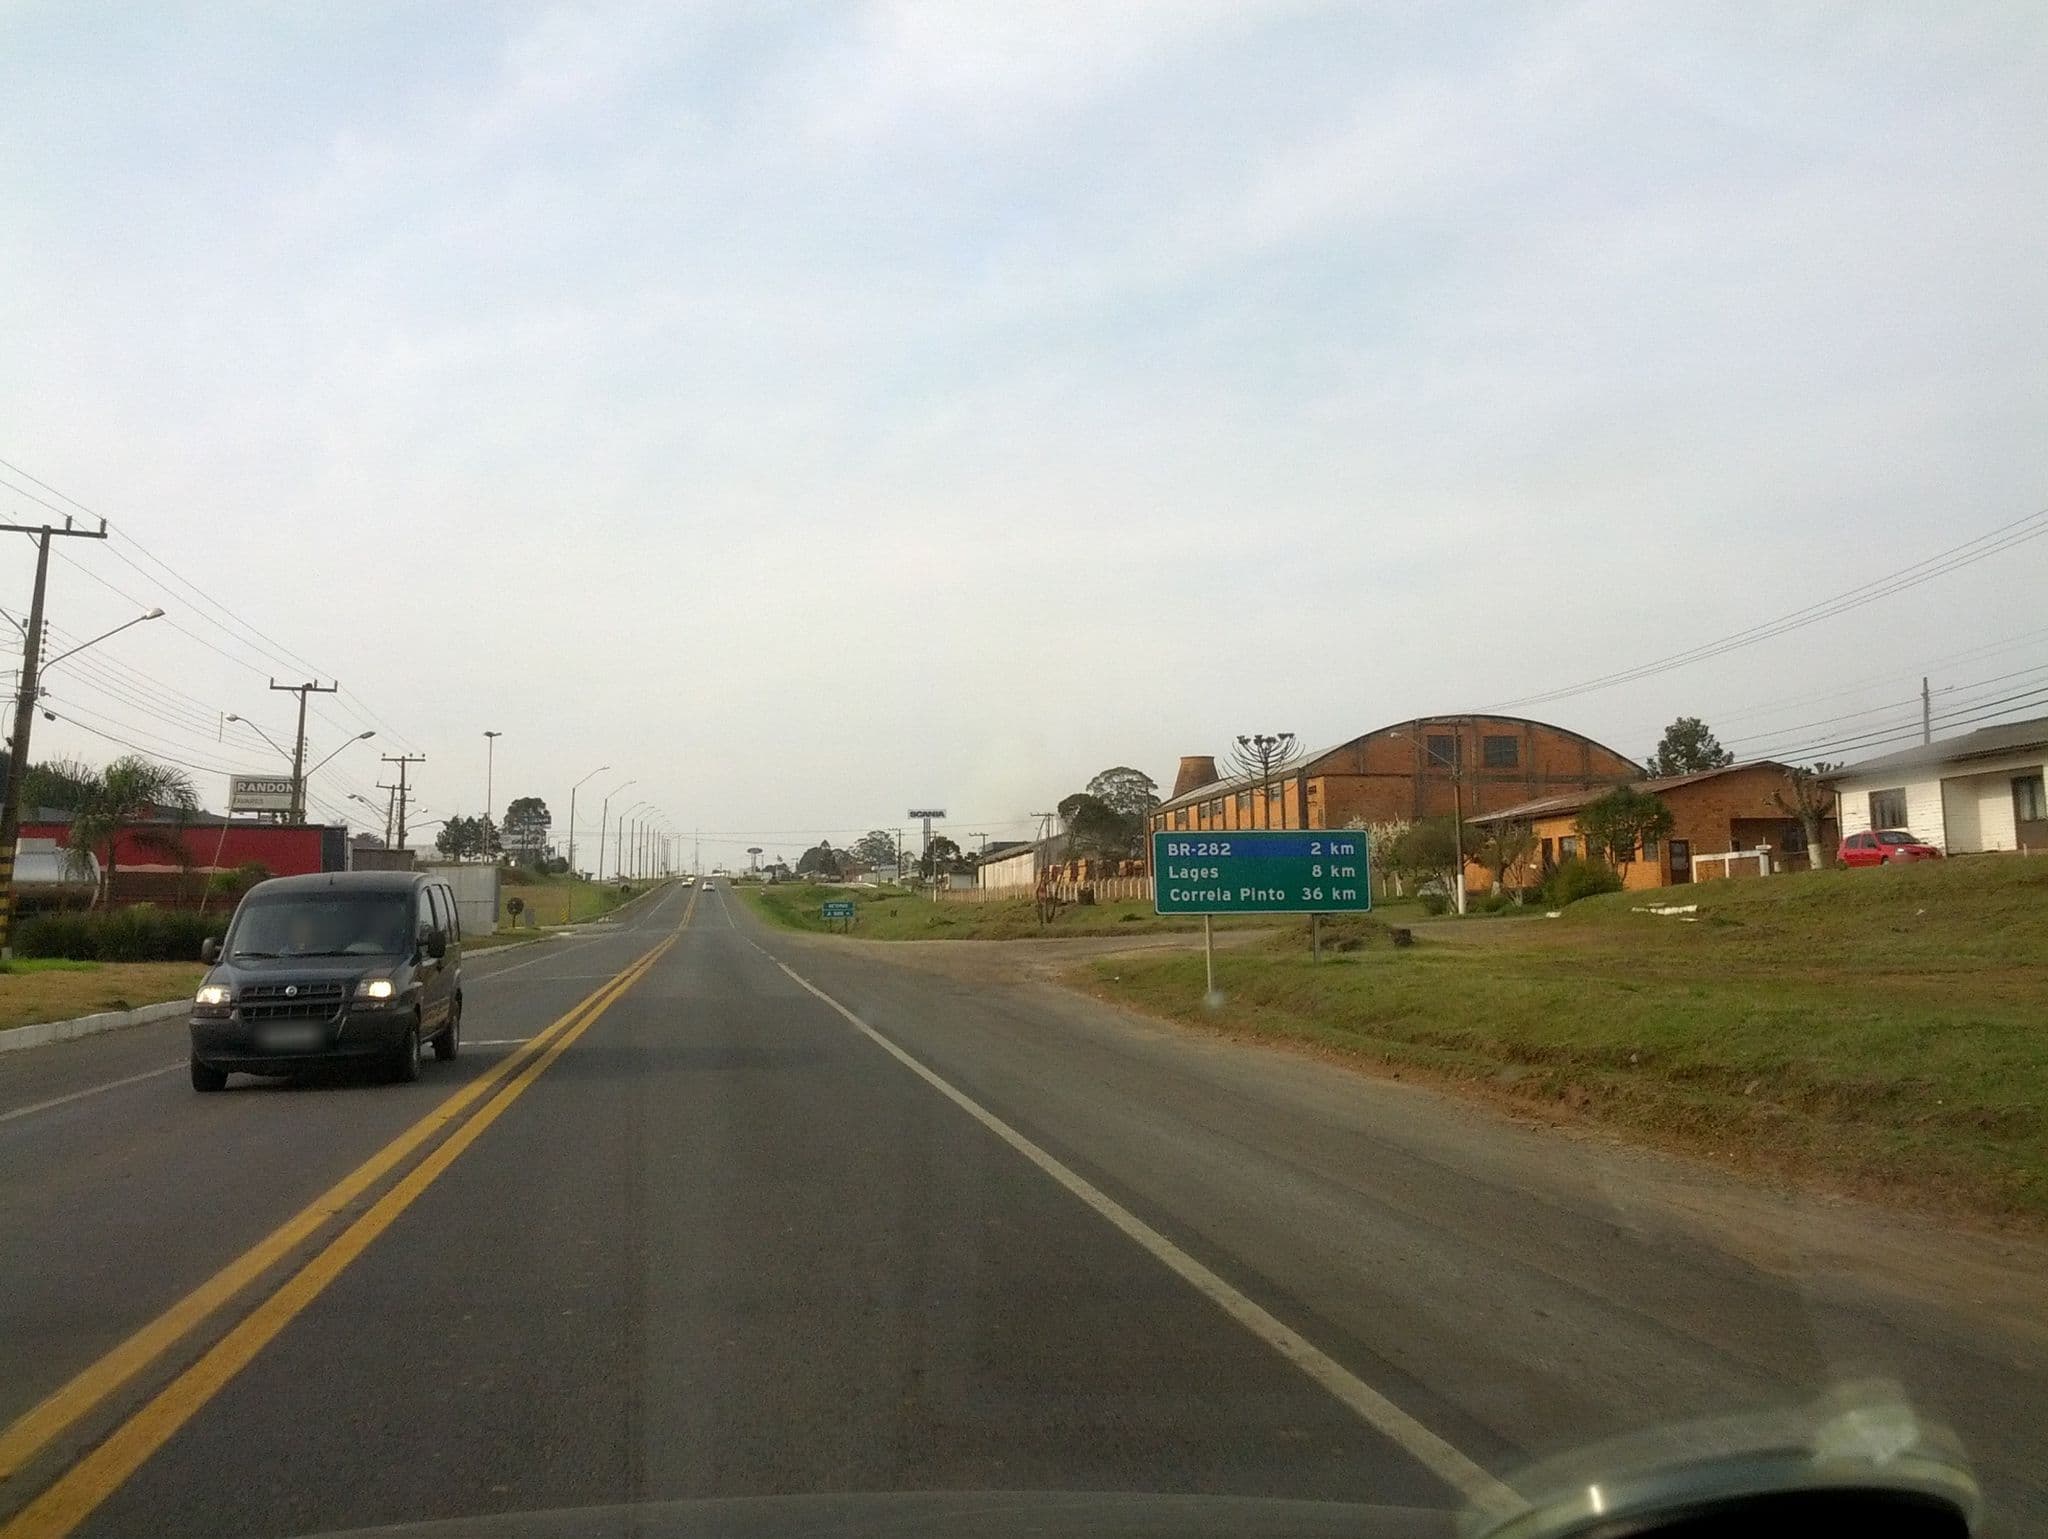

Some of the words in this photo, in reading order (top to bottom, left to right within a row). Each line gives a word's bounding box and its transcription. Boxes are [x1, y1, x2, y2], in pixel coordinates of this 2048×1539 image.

[237, 782, 295, 793] RANDON
[909, 810, 946, 818] SCANIA
[1167, 842, 1232, 857] BR-282
[1310, 841, 1322, 856] 2
[1329, 841, 1355, 856] km
[1168, 865, 1219, 882] Lages
[1311, 864, 1323, 878] 8
[1330, 864, 1356, 878] km
[1169, 887, 1232, 902] Correia
[1240, 887, 1286, 902] Pinto
[1301, 887, 1324, 901] 36
[1331, 886, 1357, 901] km
